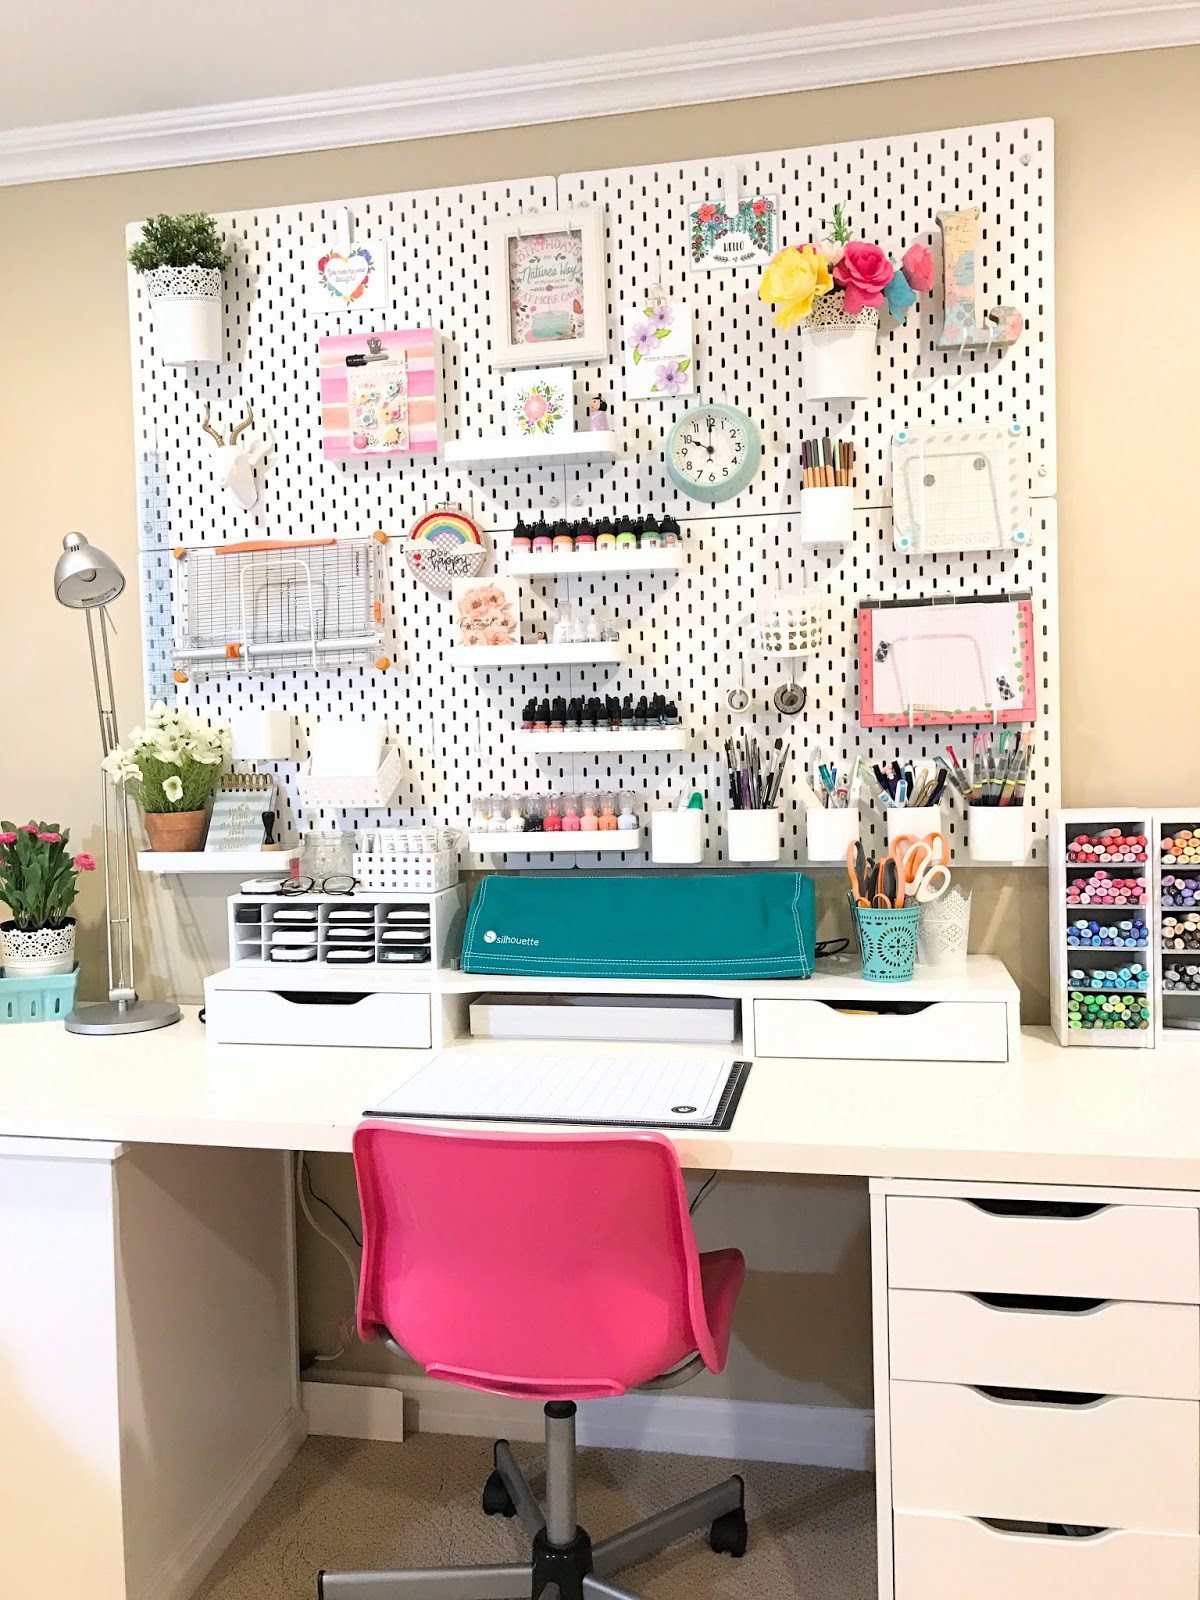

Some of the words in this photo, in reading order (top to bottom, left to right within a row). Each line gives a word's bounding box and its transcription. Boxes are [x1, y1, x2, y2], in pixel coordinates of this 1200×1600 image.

[517, 239, 581, 262] BIRTHDAYS
[724, 241, 745, 252] HELLO
[559, 262, 581, 281] Way
[516, 290, 534, 302] EAT
[534, 294, 559, 304] MORE
[561, 287, 582, 301] CAKE
[706, 417, 715, 427] 12
[720, 420, 724, 430] 1
[693, 423, 699, 433] 11
[729, 429, 736, 438] 2
[683, 434, 692, 444] 10
[735, 442, 741, 452] 3
[681, 448, 688, 457] 9
[686, 461, 693, 470] 8
[731, 456, 738, 465] 4
[696, 469, 703, 479] 7
[708, 472, 715, 481] 6
[722, 467, 729, 476] 5
[427, 549, 471, 573] happy
[227, 802, 245, 819] just
[219, 817, 255, 830] notepad
[496, 935, 540, 946] silhouette
